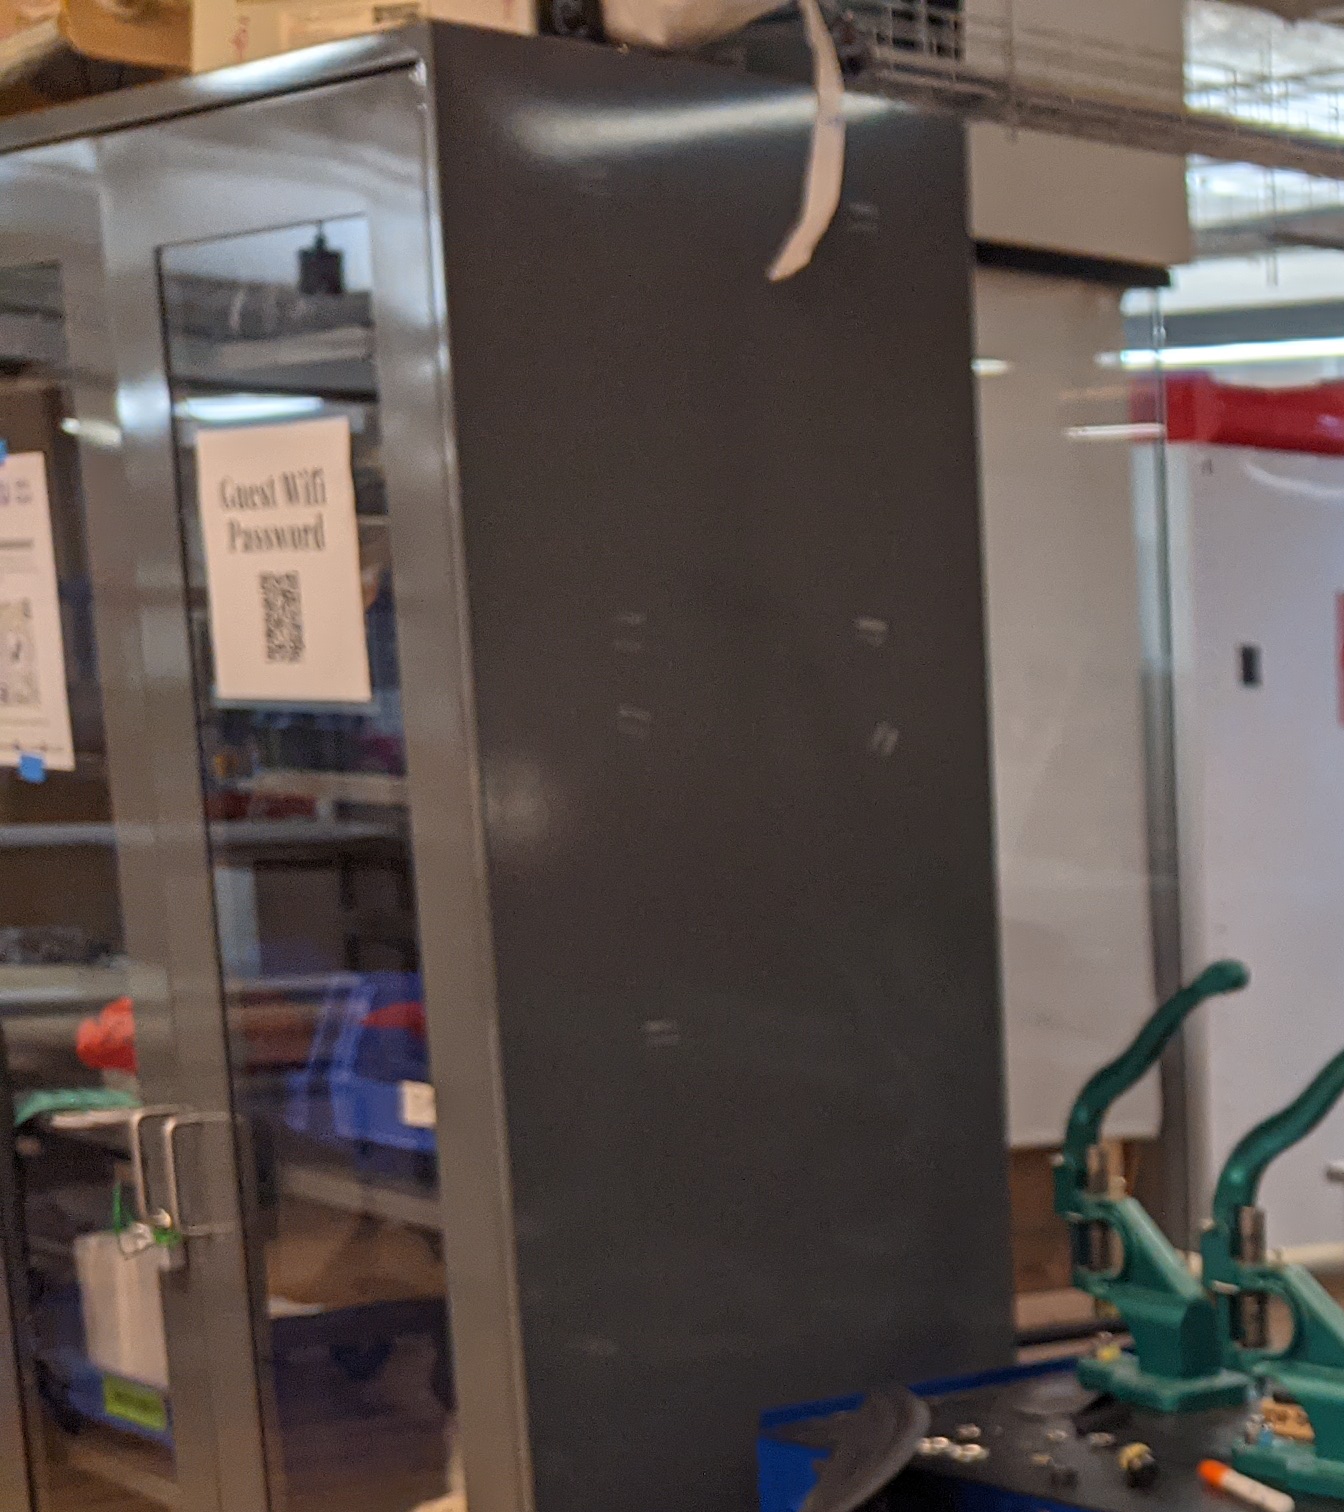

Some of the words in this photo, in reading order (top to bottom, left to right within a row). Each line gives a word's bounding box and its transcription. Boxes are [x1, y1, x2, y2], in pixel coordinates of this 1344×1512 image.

[219, 474, 276, 509] Guest
[281, 467, 327, 505] Wifi
[228, 512, 325, 553] Password
